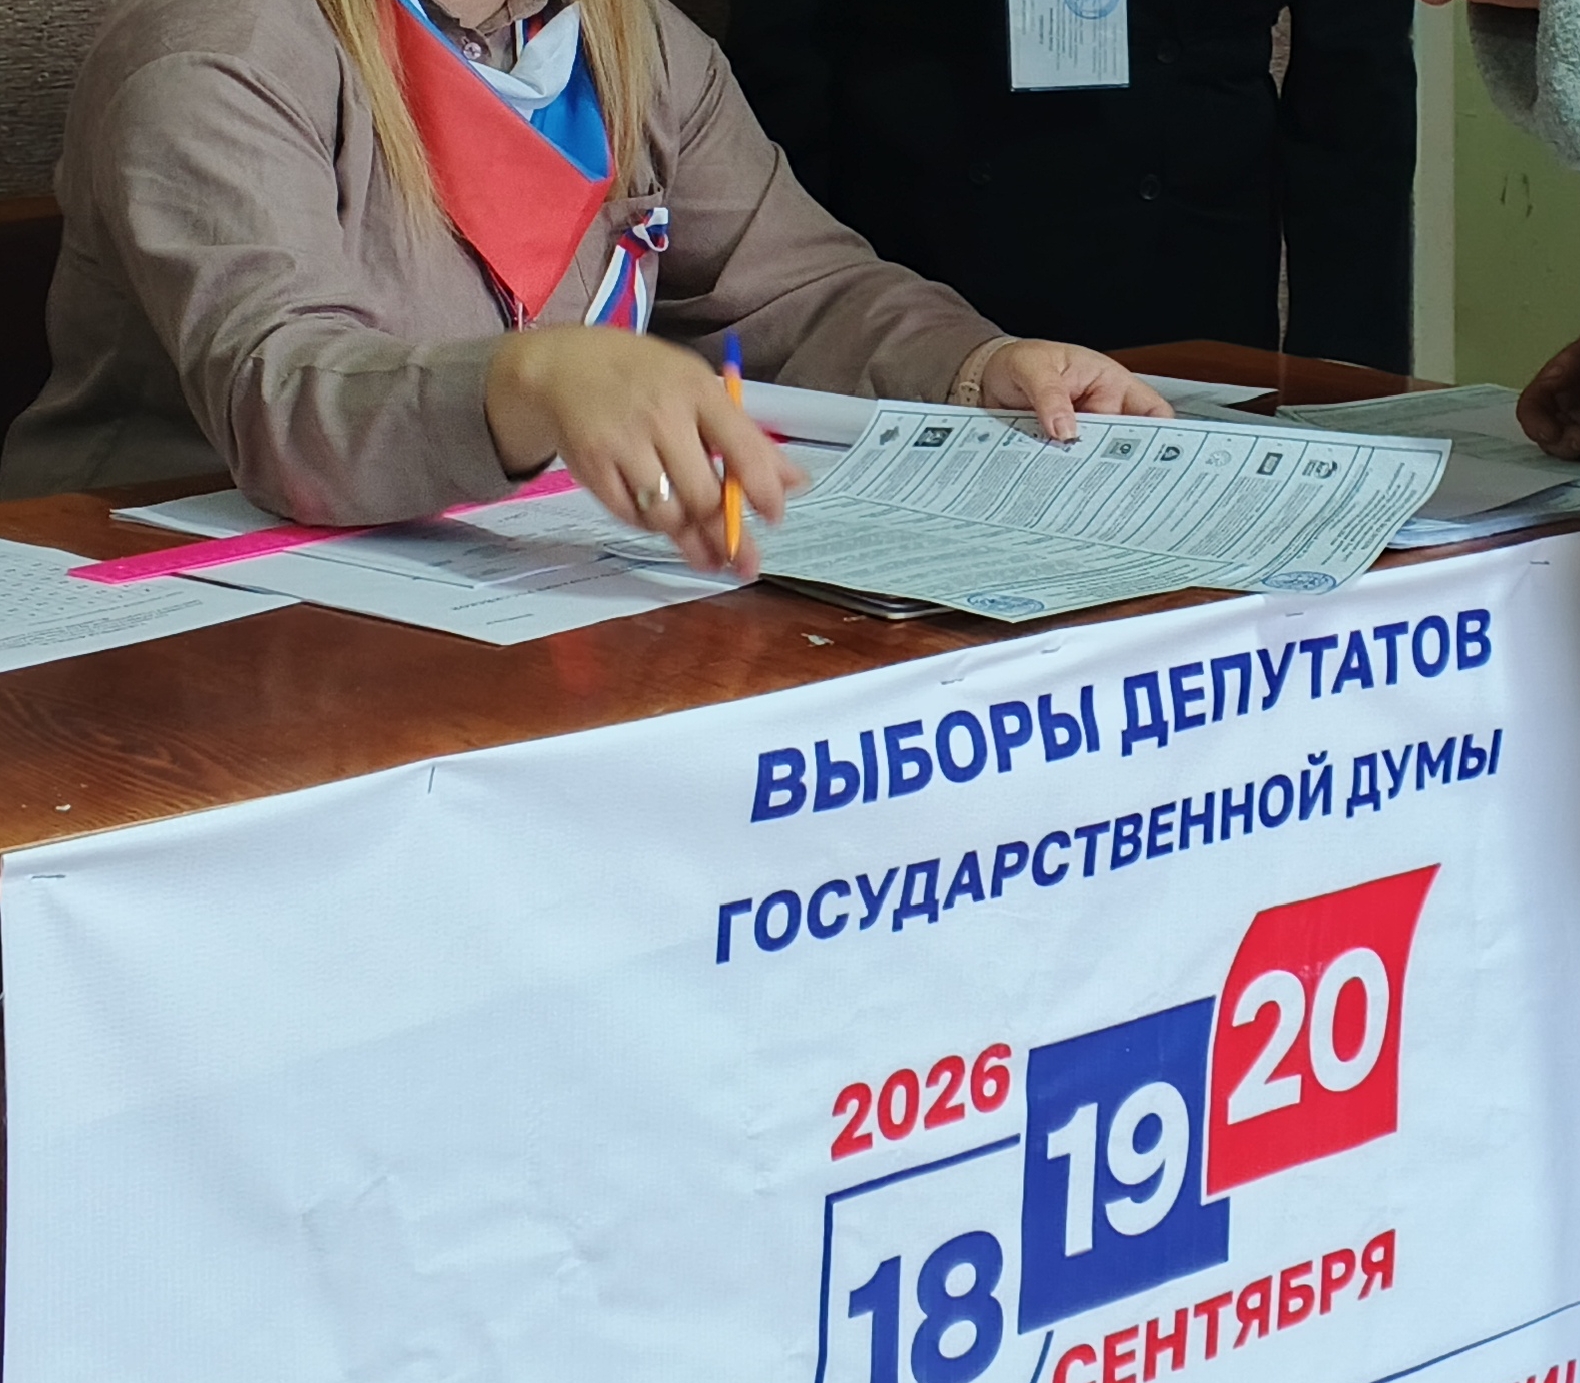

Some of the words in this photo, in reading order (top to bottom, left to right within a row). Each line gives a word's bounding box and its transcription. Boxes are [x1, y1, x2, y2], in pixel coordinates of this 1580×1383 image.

[750, 695, 1100, 822] ВЫБОРЫ
[1119, 608, 1493, 755] ДЕПУТАТОВ
[715, 754, 1333, 964] ГОСУДАРСТВЕННОЙ
[1345, 728, 1504, 817] ДУМЫ
[830, 1043, 1012, 1161] 2026
[1226, 945, 1392, 1126] 20
[1046, 1081, 1190, 1258] 19
[848, 1229, 1004, 1383] 18
[1052, 1228, 1397, 1383] СЕНТЯБРЯ
